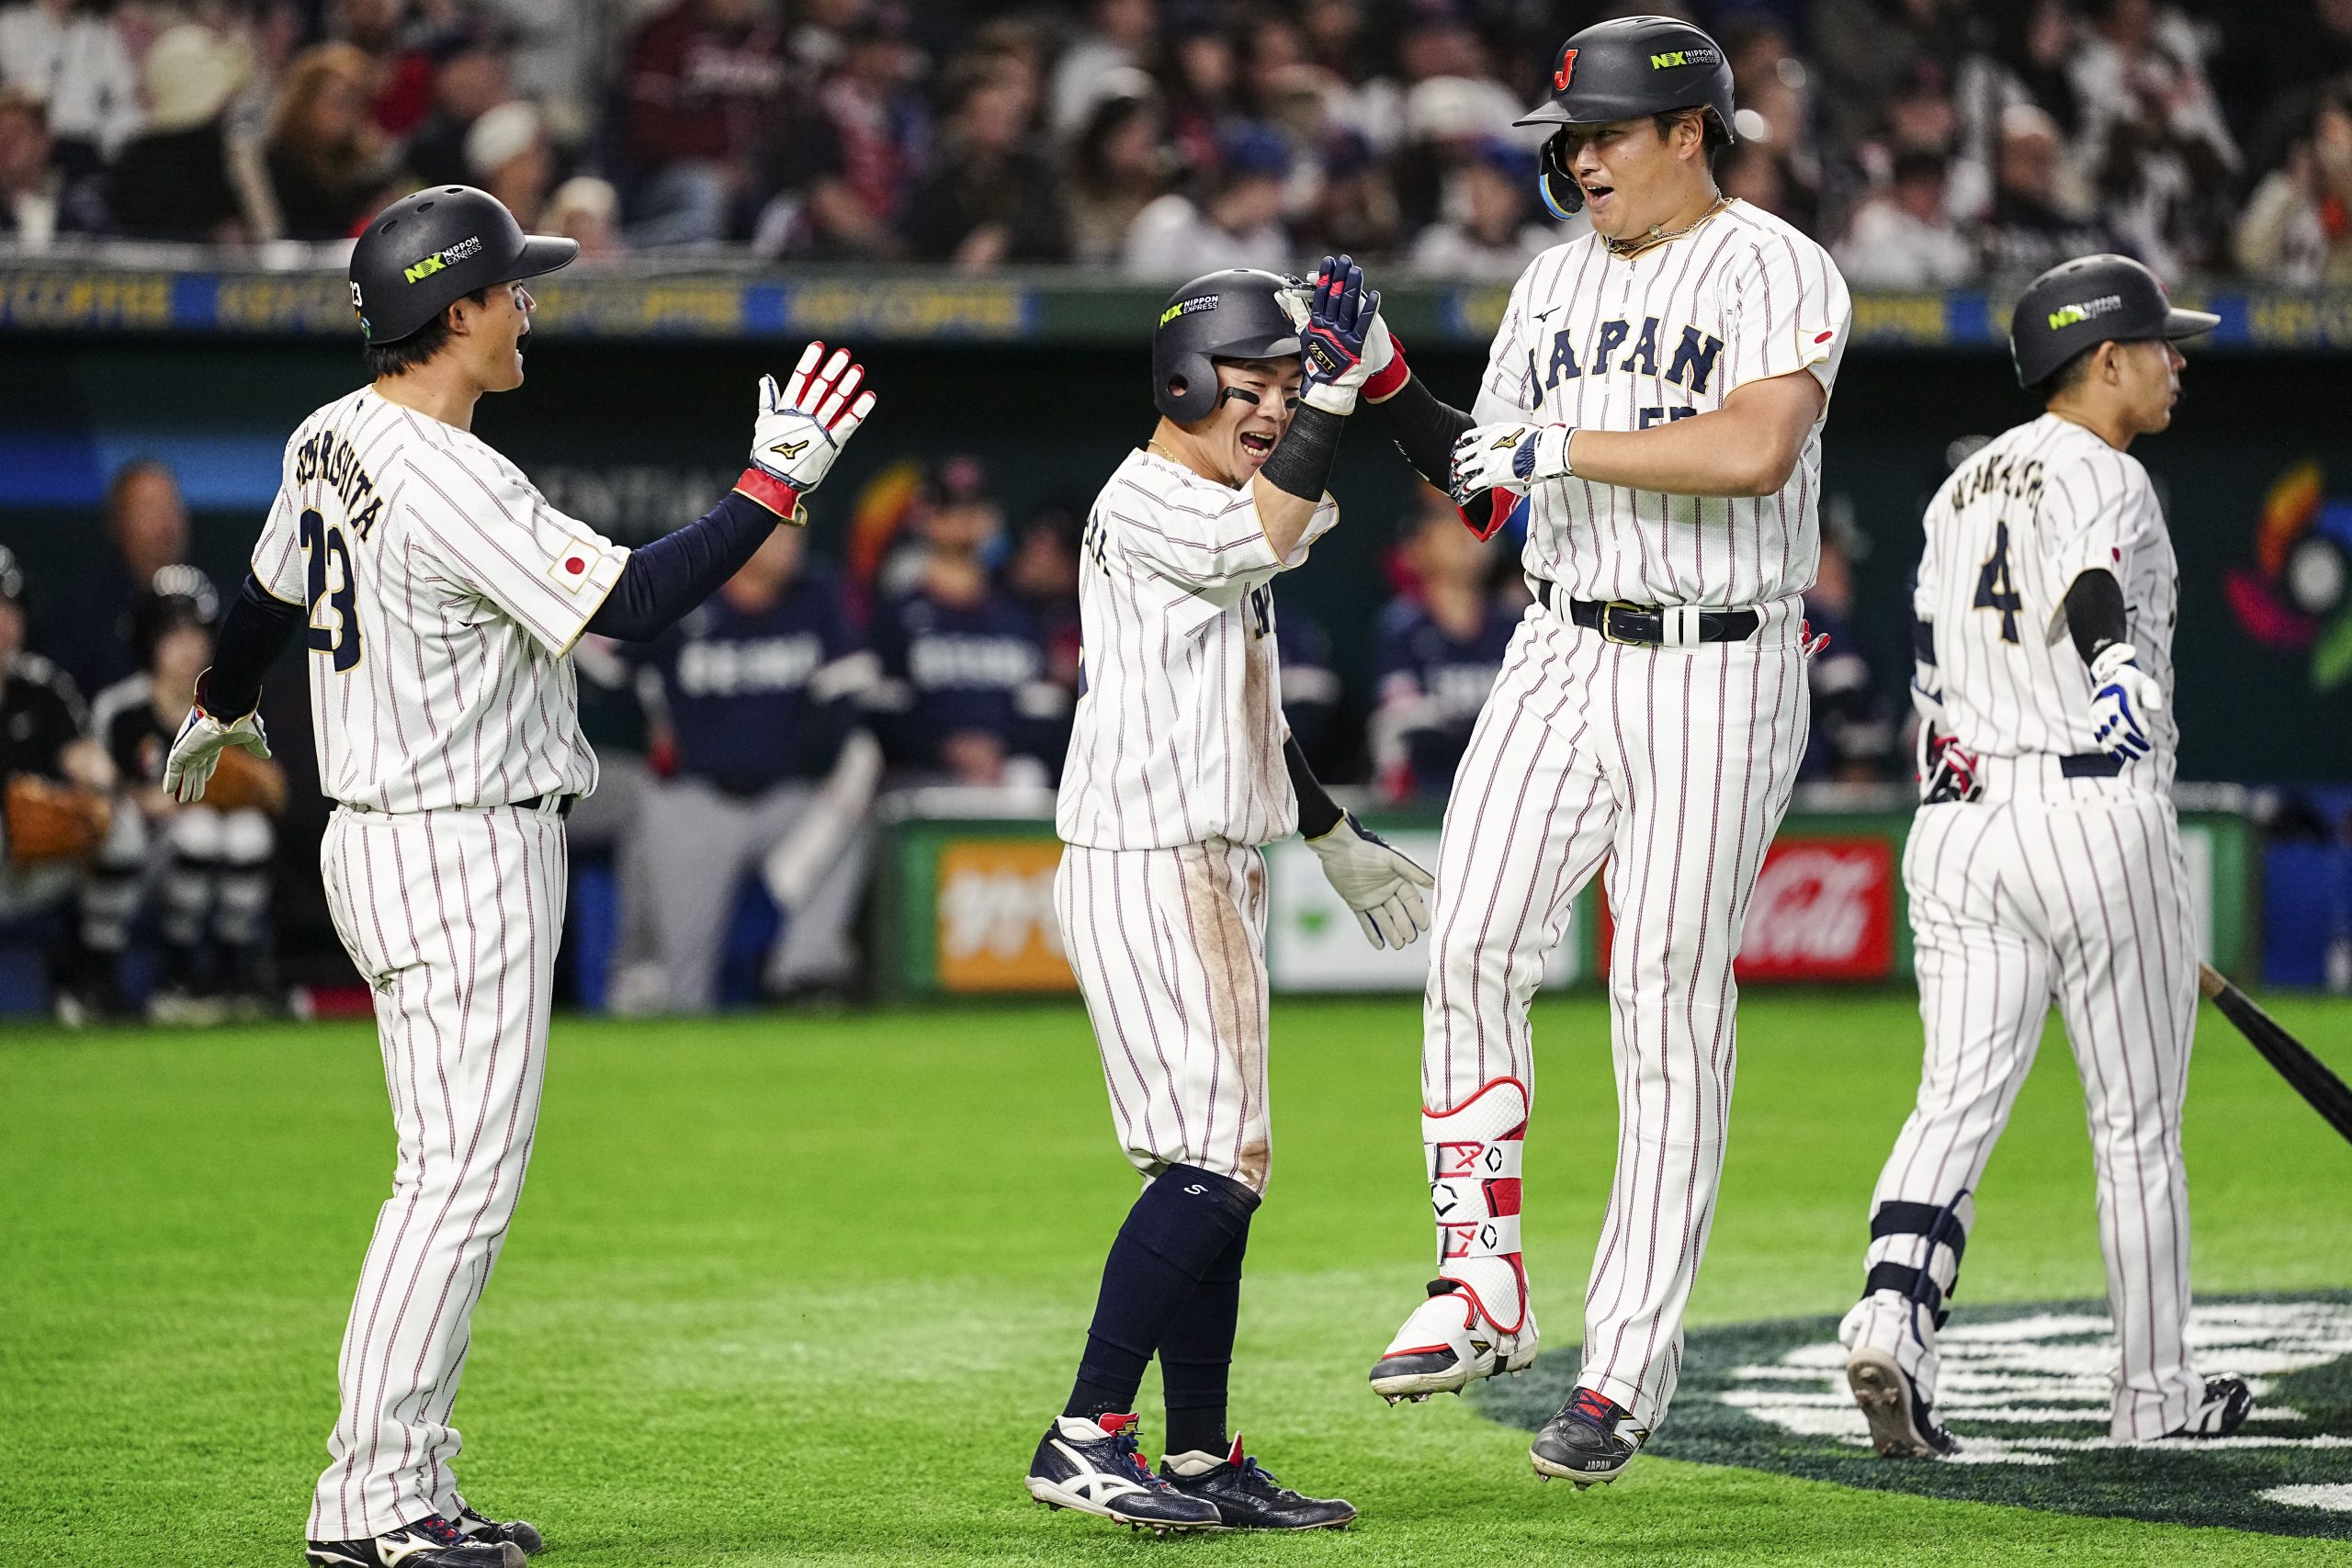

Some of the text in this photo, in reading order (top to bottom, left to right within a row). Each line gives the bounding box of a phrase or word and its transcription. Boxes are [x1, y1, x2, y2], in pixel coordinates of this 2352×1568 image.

[1651, 51, 1688, 70] NX
[1685, 50, 1714, 58] NIPPON
[1688, 56, 1716, 64] EXPRESS
[1554, 49, 1579, 91] J
[442, 235, 480, 259] NIPPON
[445, 243, 482, 265] EXPRESS
[404, 253, 447, 284] NX
[1182, 302, 1217, 314] EXPRESS
[1183, 295, 1218, 308] NIPPON
[300, 506, 362, 674] 23
[1973, 520, 2022, 644] 4
[1585, 1460, 1611, 1471] JAPAN
